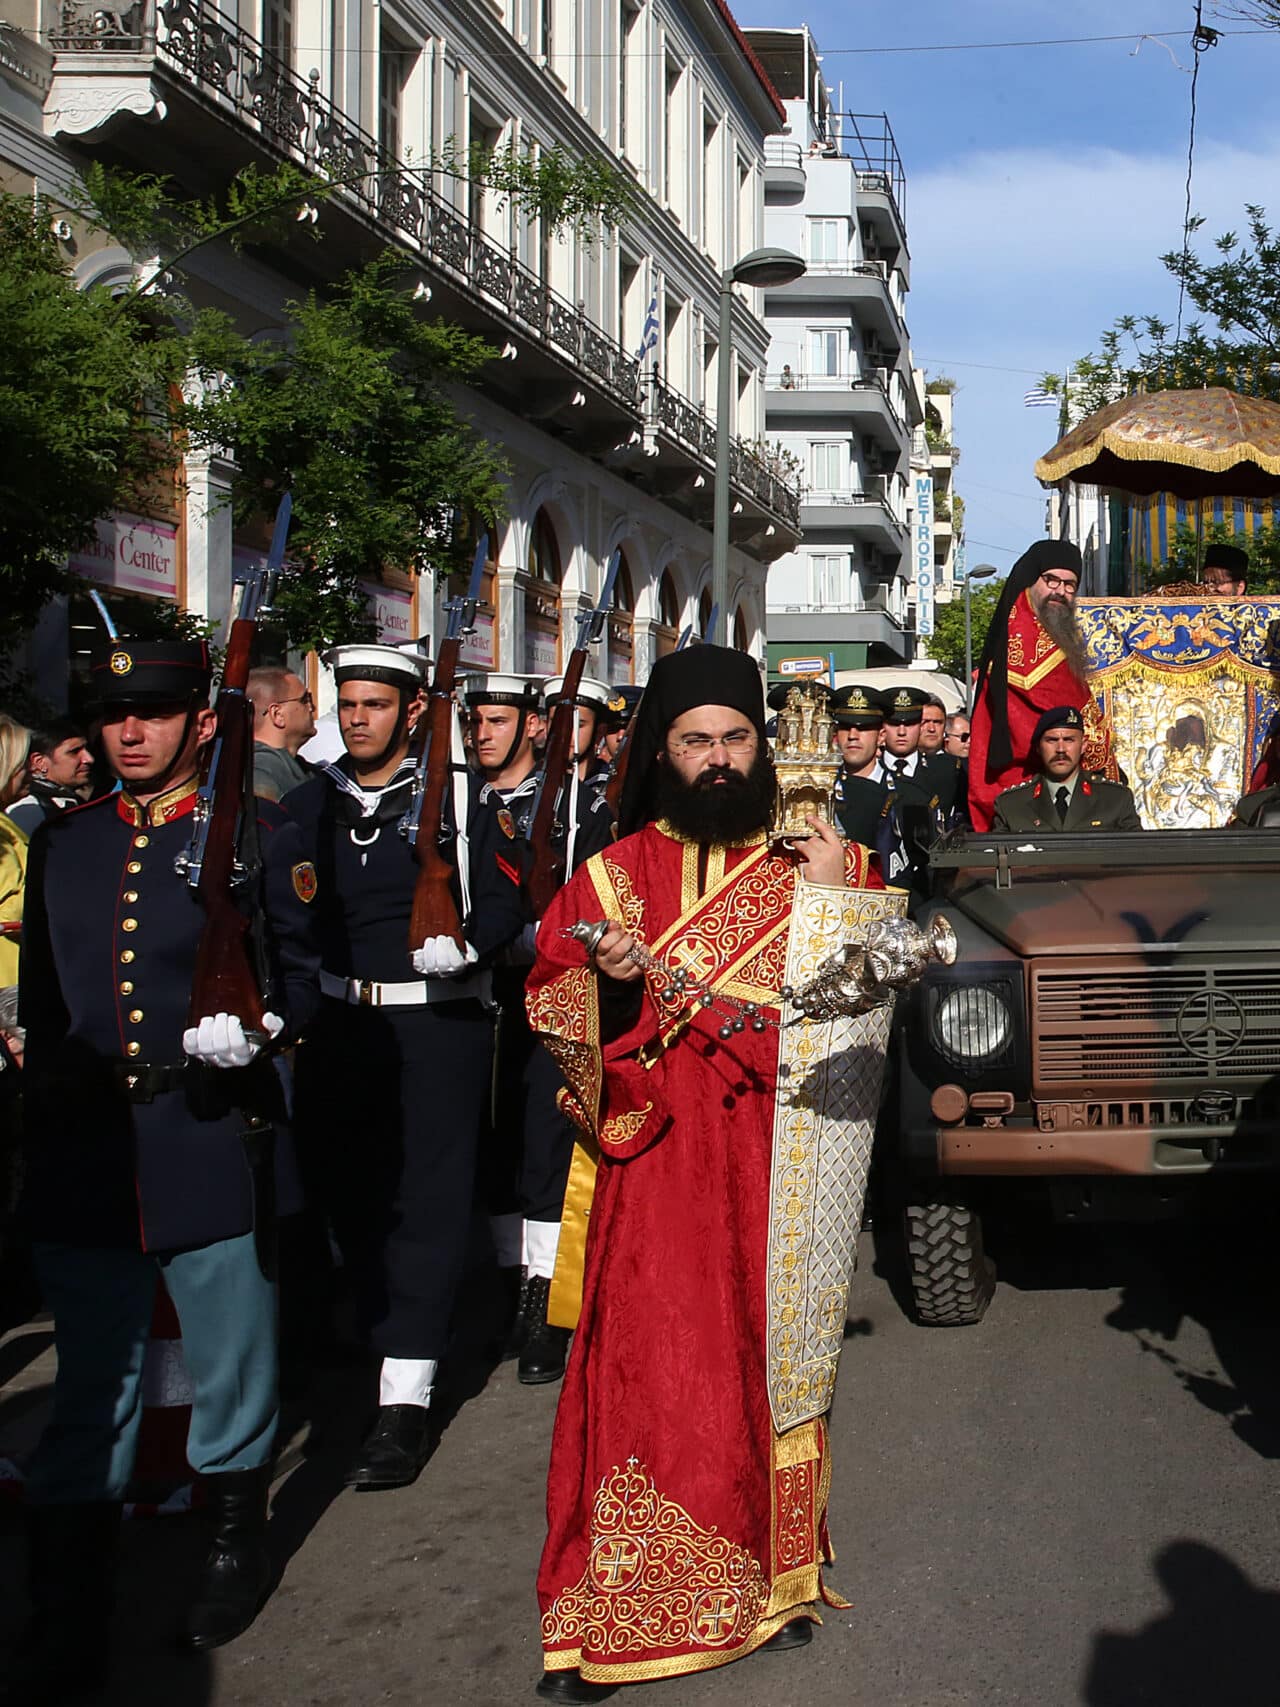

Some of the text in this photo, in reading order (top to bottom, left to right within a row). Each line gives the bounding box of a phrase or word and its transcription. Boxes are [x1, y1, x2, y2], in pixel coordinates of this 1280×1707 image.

[120, 535, 170, 574] Center
[916, 479, 931, 634] METROPOLIS
[378, 604, 408, 631] Center
